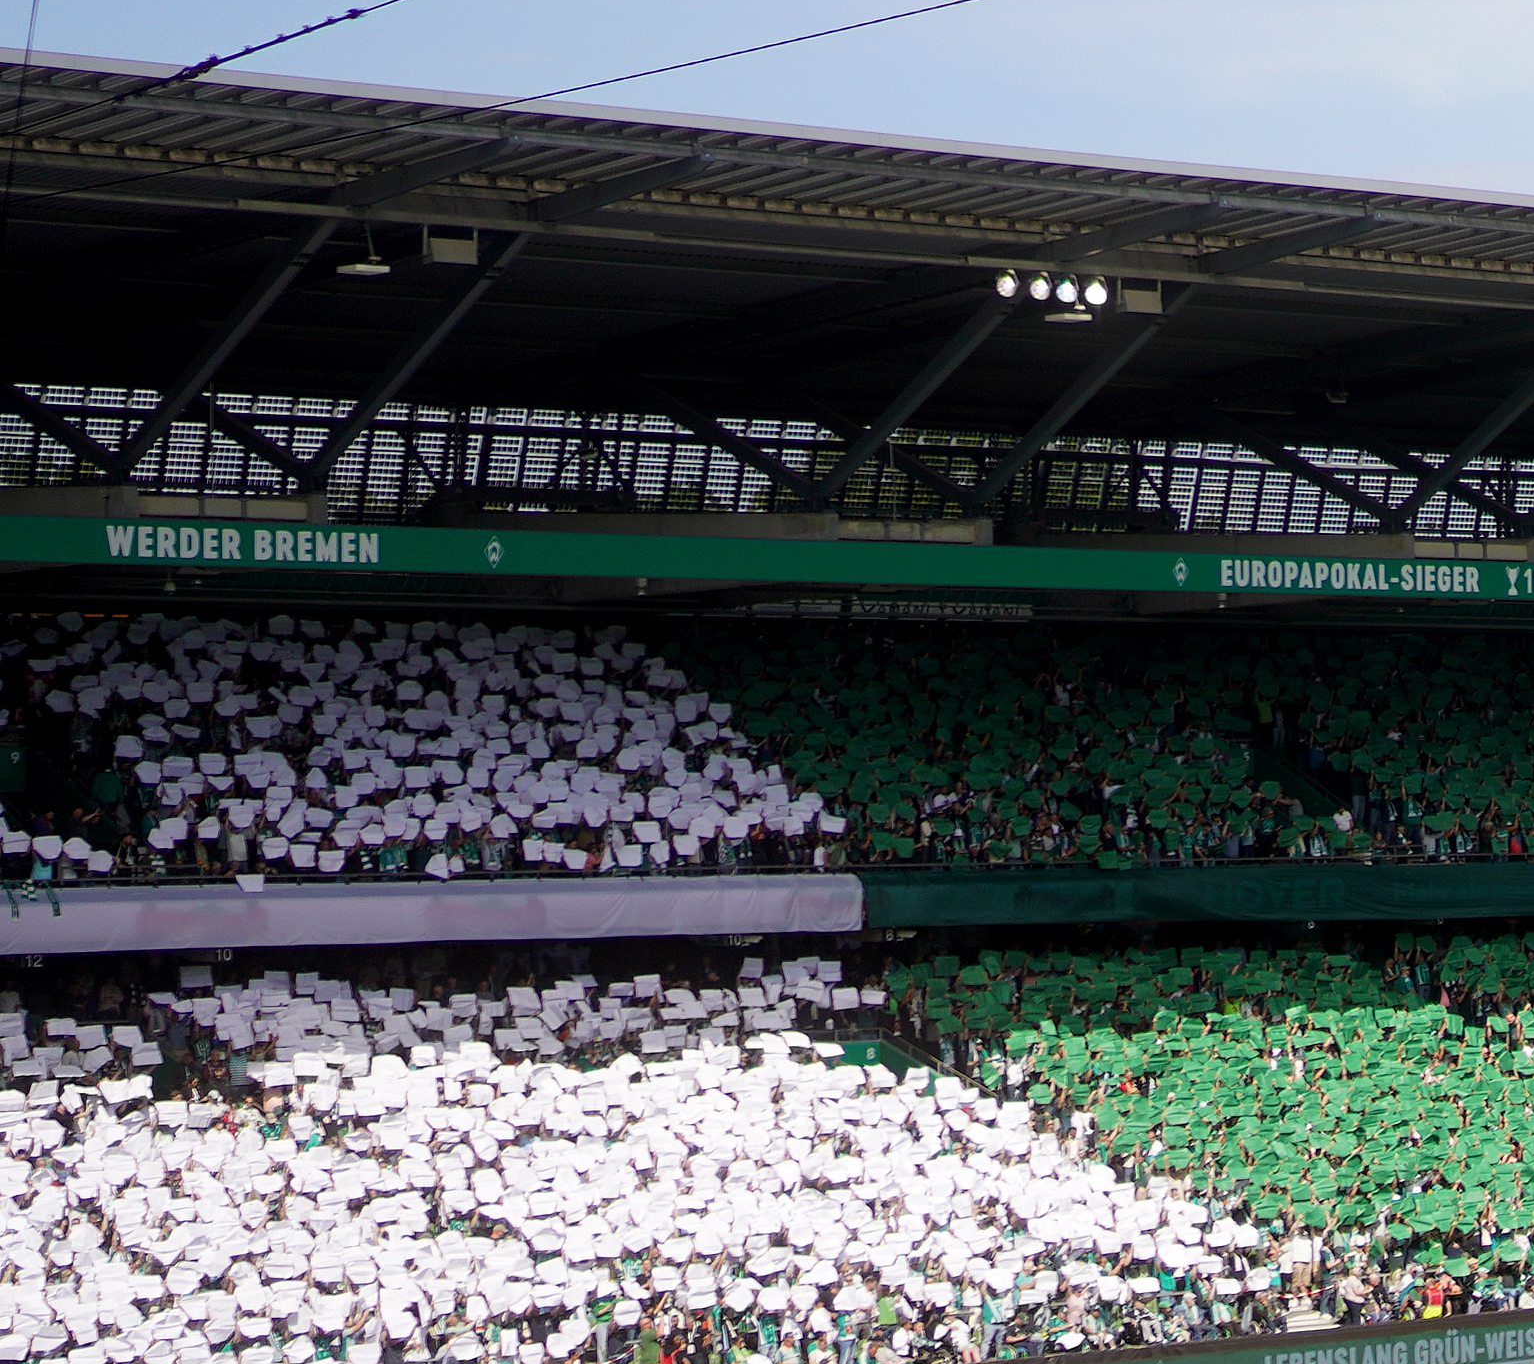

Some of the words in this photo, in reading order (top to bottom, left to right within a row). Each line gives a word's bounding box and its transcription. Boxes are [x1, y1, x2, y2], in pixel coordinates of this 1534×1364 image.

[105, 524, 241, 561] WERDER
[253, 529, 380, 565] BREMEN
[1219, 558, 1481, 595] EUROPAPOKAL-SIEGER
[24, 955, 44, 968] 12
[215, 948, 233, 962] 10
